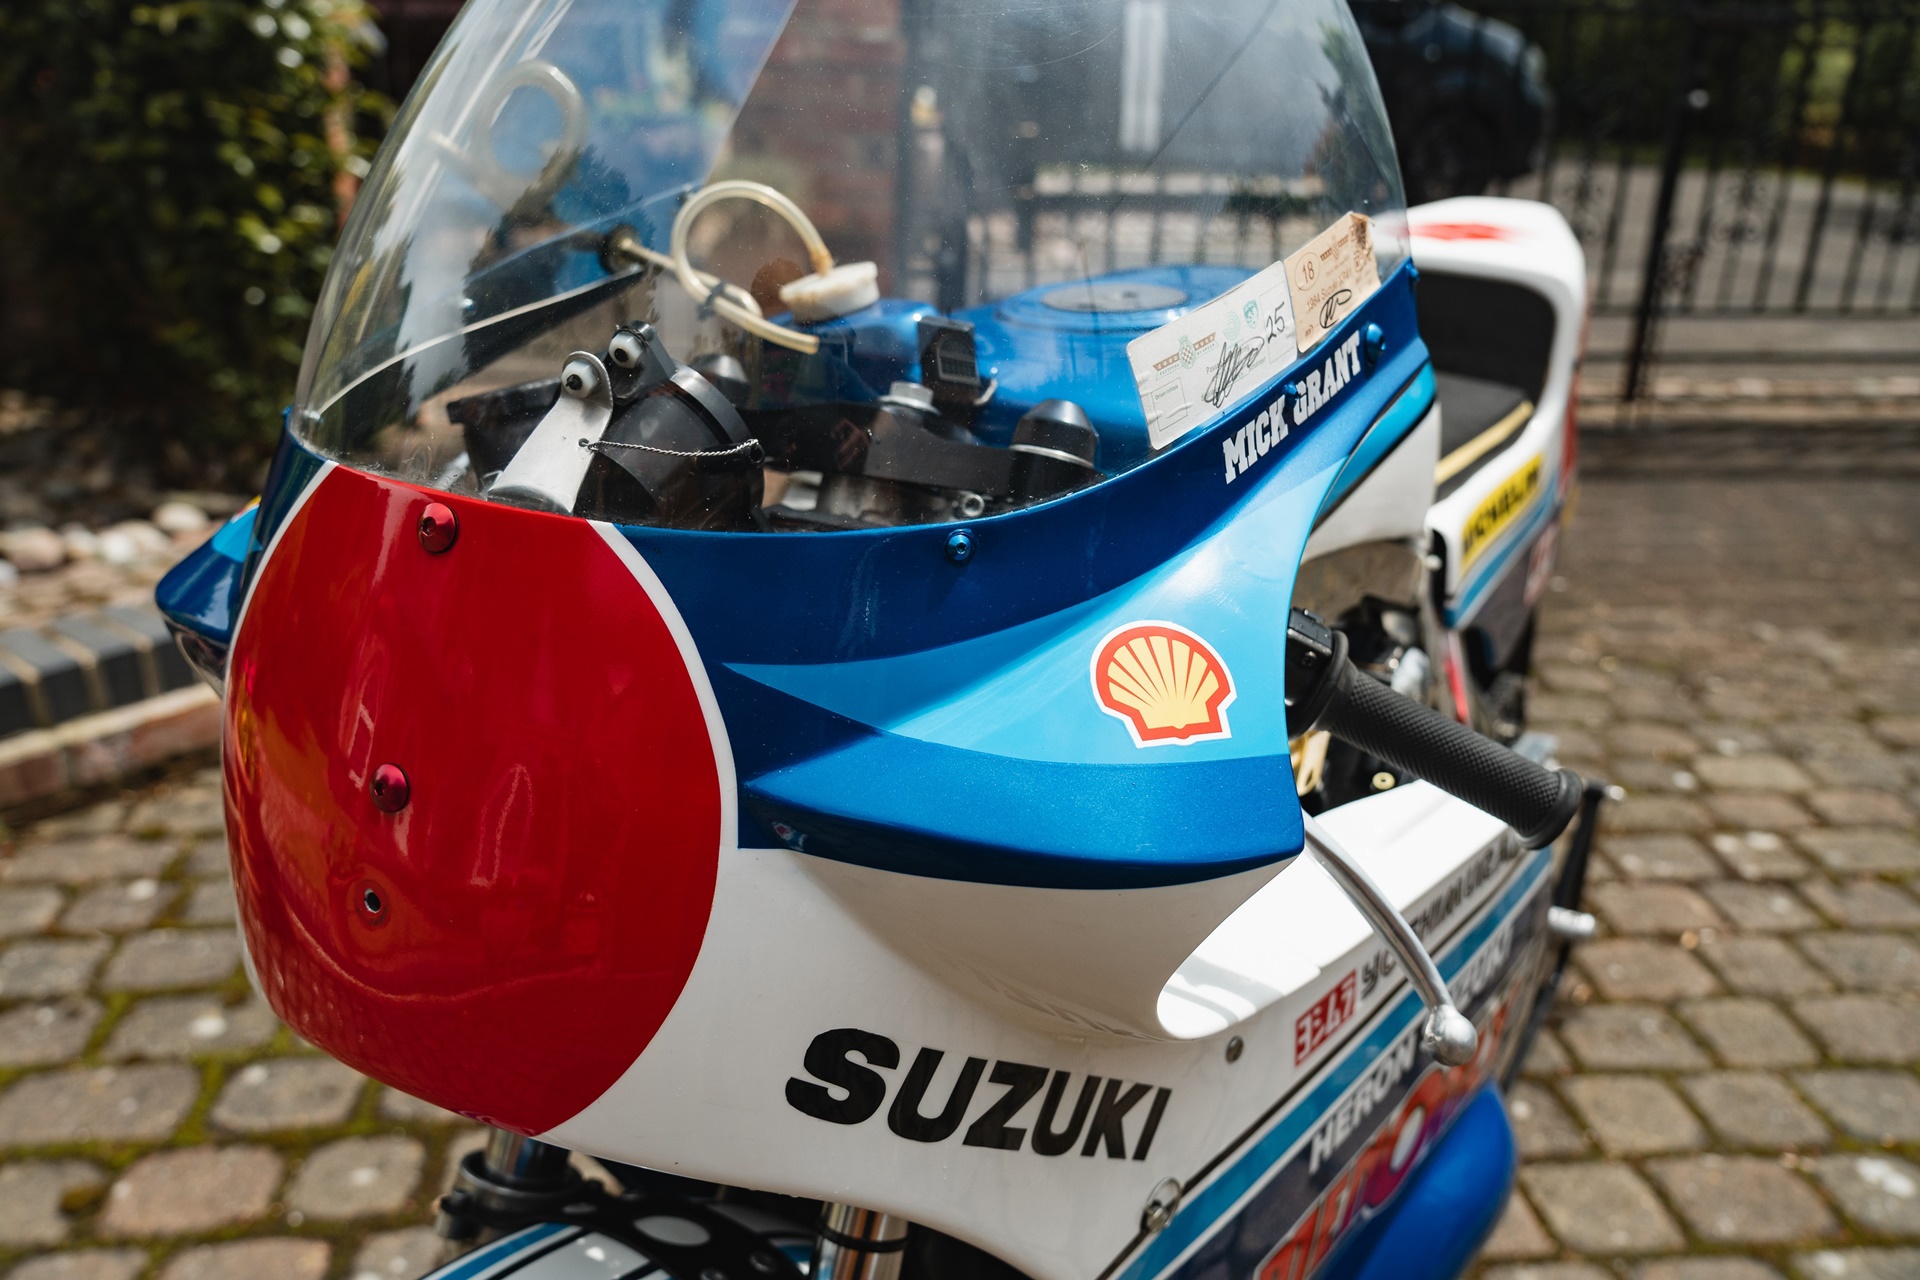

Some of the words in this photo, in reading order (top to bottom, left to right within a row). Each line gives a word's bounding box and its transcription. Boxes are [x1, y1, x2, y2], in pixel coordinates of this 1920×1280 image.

[1265, 301, 1285, 344] 25
[1302, 260, 1315, 283] 18
[1222, 395, 1291, 485] MICK
[1294, 330, 1362, 426] GRANT
[785, 1028, 1173, 1162] SUZUKI
[1308, 1027, 1419, 1175] HERON
